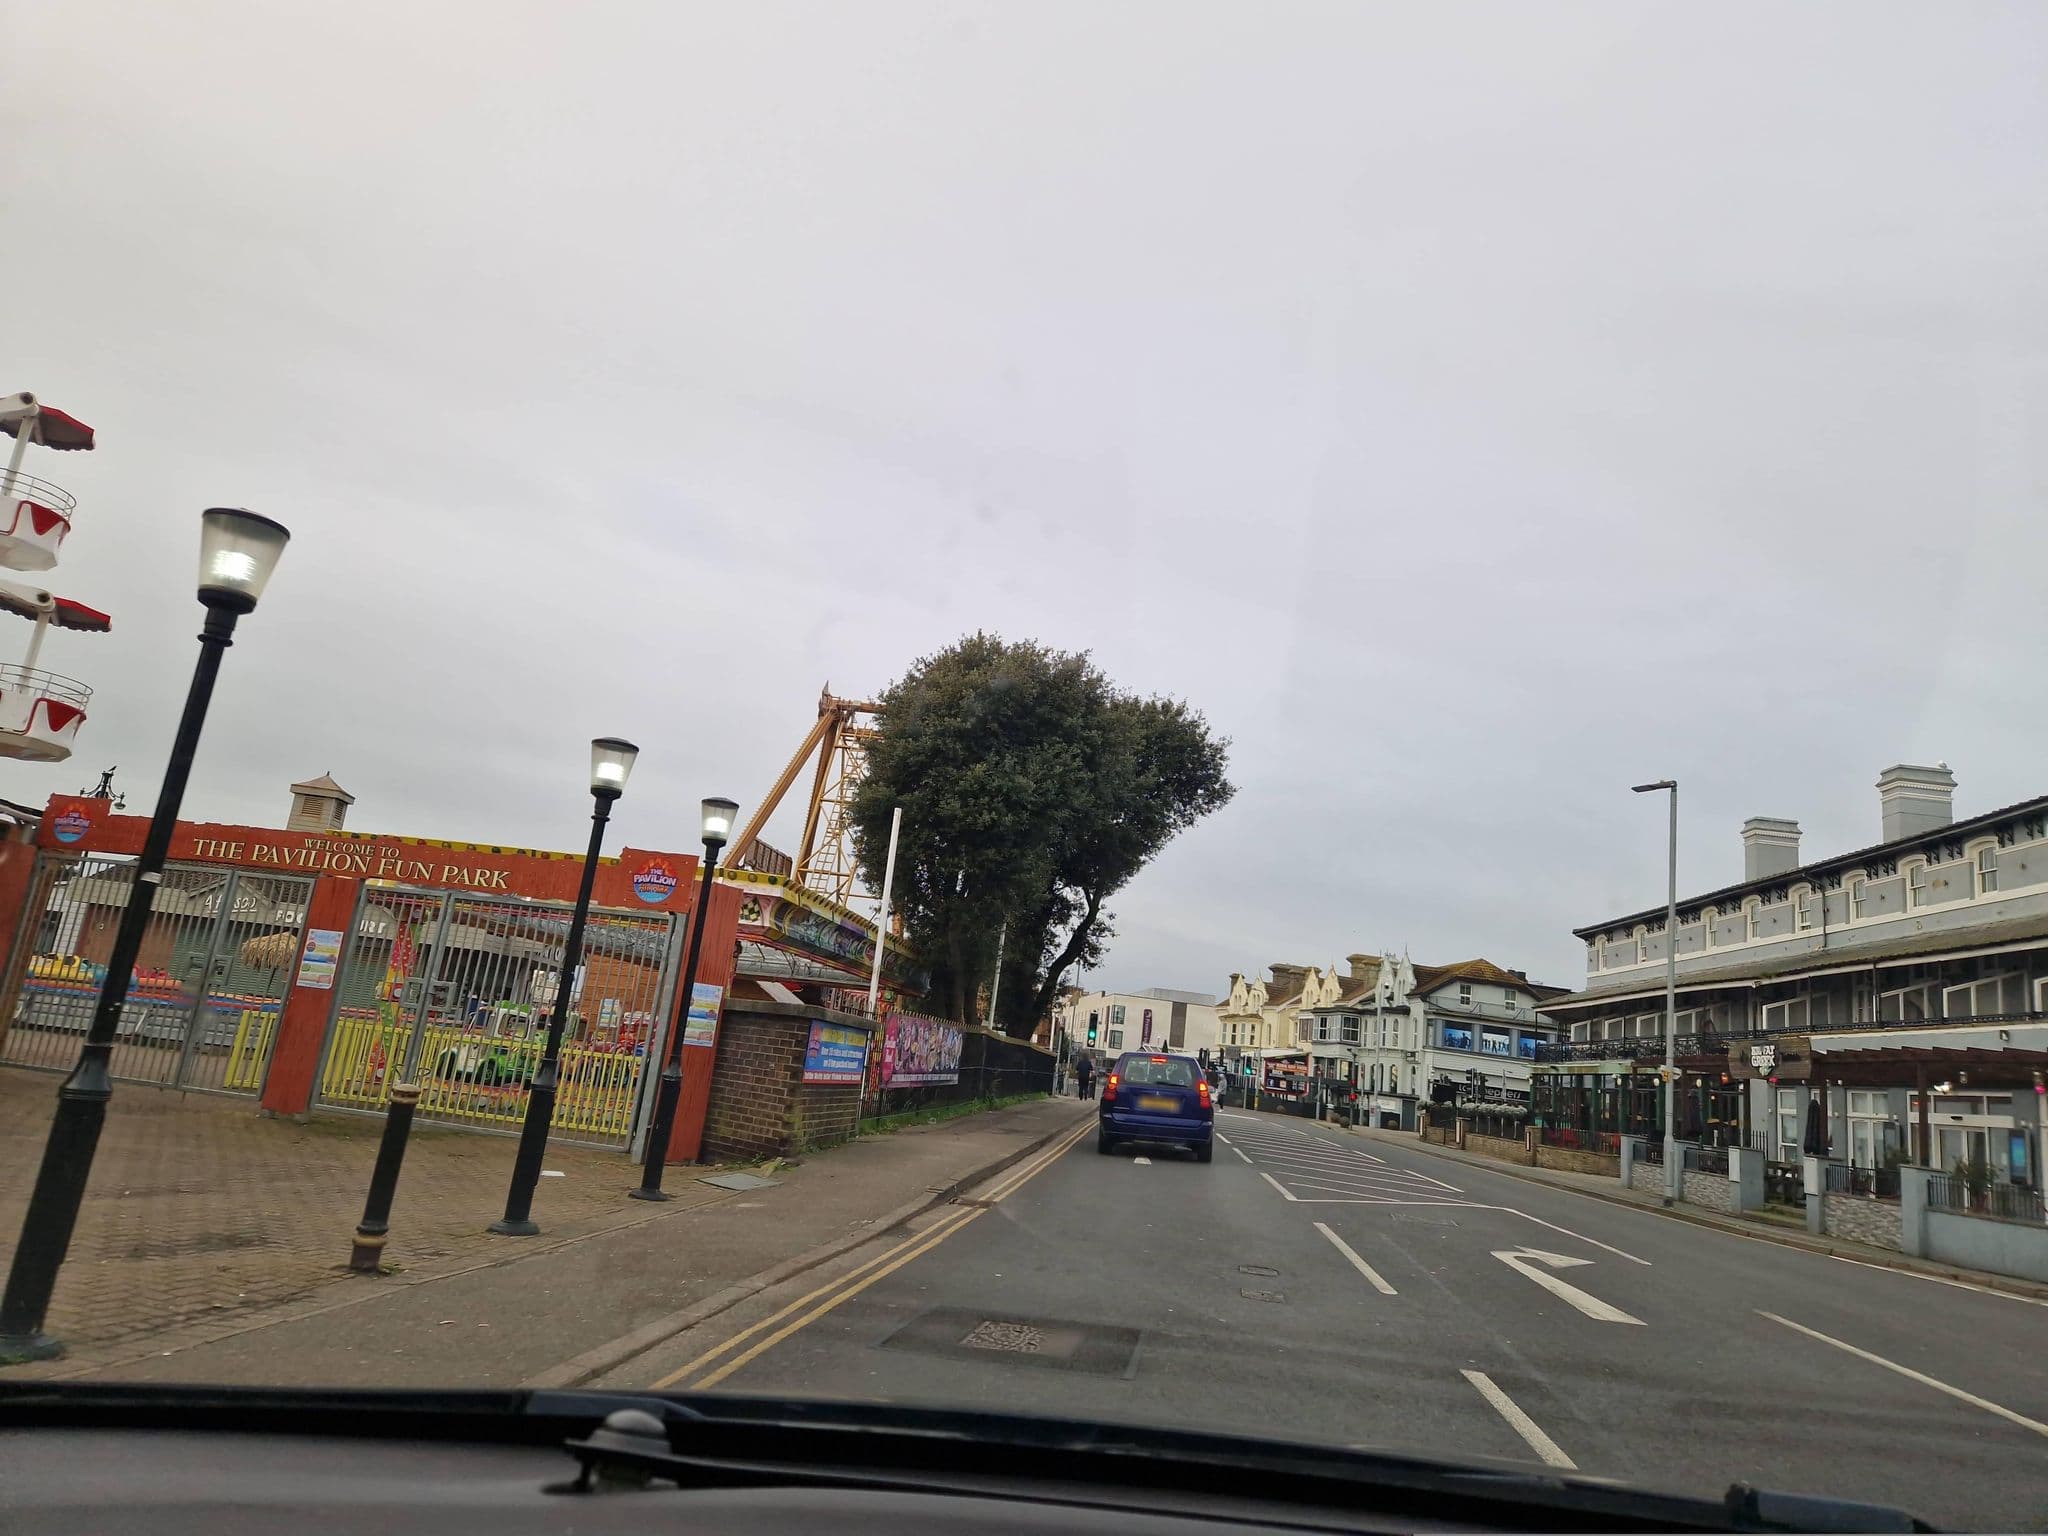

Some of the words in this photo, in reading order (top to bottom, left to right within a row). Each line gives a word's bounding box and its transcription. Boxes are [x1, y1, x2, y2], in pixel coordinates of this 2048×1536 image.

[305, 838, 375, 856] WELCOME
[380, 846, 399, 858] TO
[193, 838, 246, 860] THE
[252, 844, 371, 873] PAVILION
[375, 857, 436, 881] FUN
[440, 865, 511, 889] PARK
[633, 874, 677, 886] PAVILION
